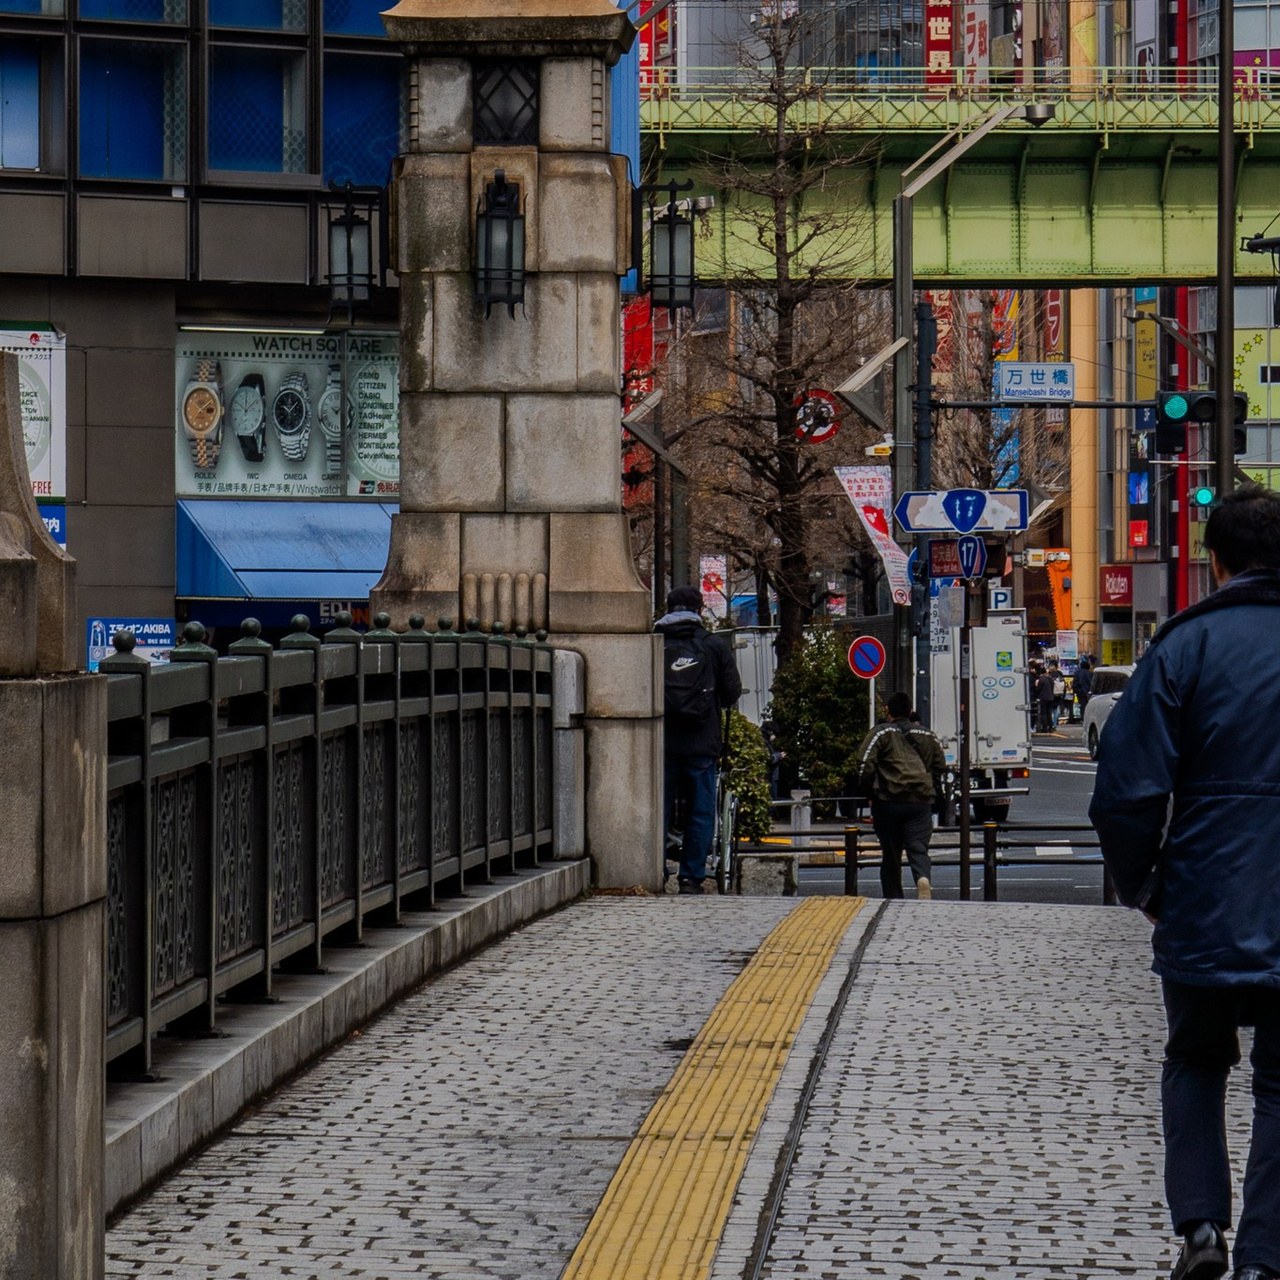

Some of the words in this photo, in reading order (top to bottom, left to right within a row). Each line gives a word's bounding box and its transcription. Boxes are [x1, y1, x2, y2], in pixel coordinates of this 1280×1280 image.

[252, 336, 312, 352] WATCH
[1007, 369, 1068, 385] 万世橋
[358, 382, 387, 390] CITIZEN
[1004, 387, 1047, 397] Manseibashi
[1048, 387, 1072, 398] Bridge
[358, 402, 394, 410] LONGINES
[358, 422, 385, 430] ZENITH
[358, 432, 388, 440] HERMES
[194, 471, 217, 481] ROLEX
[283, 472, 308, 481] OMEGA
[960, 541, 975, 568] 17
[1105, 572, 1129, 595] Rakuten
[994, 591, 1009, 609] P
